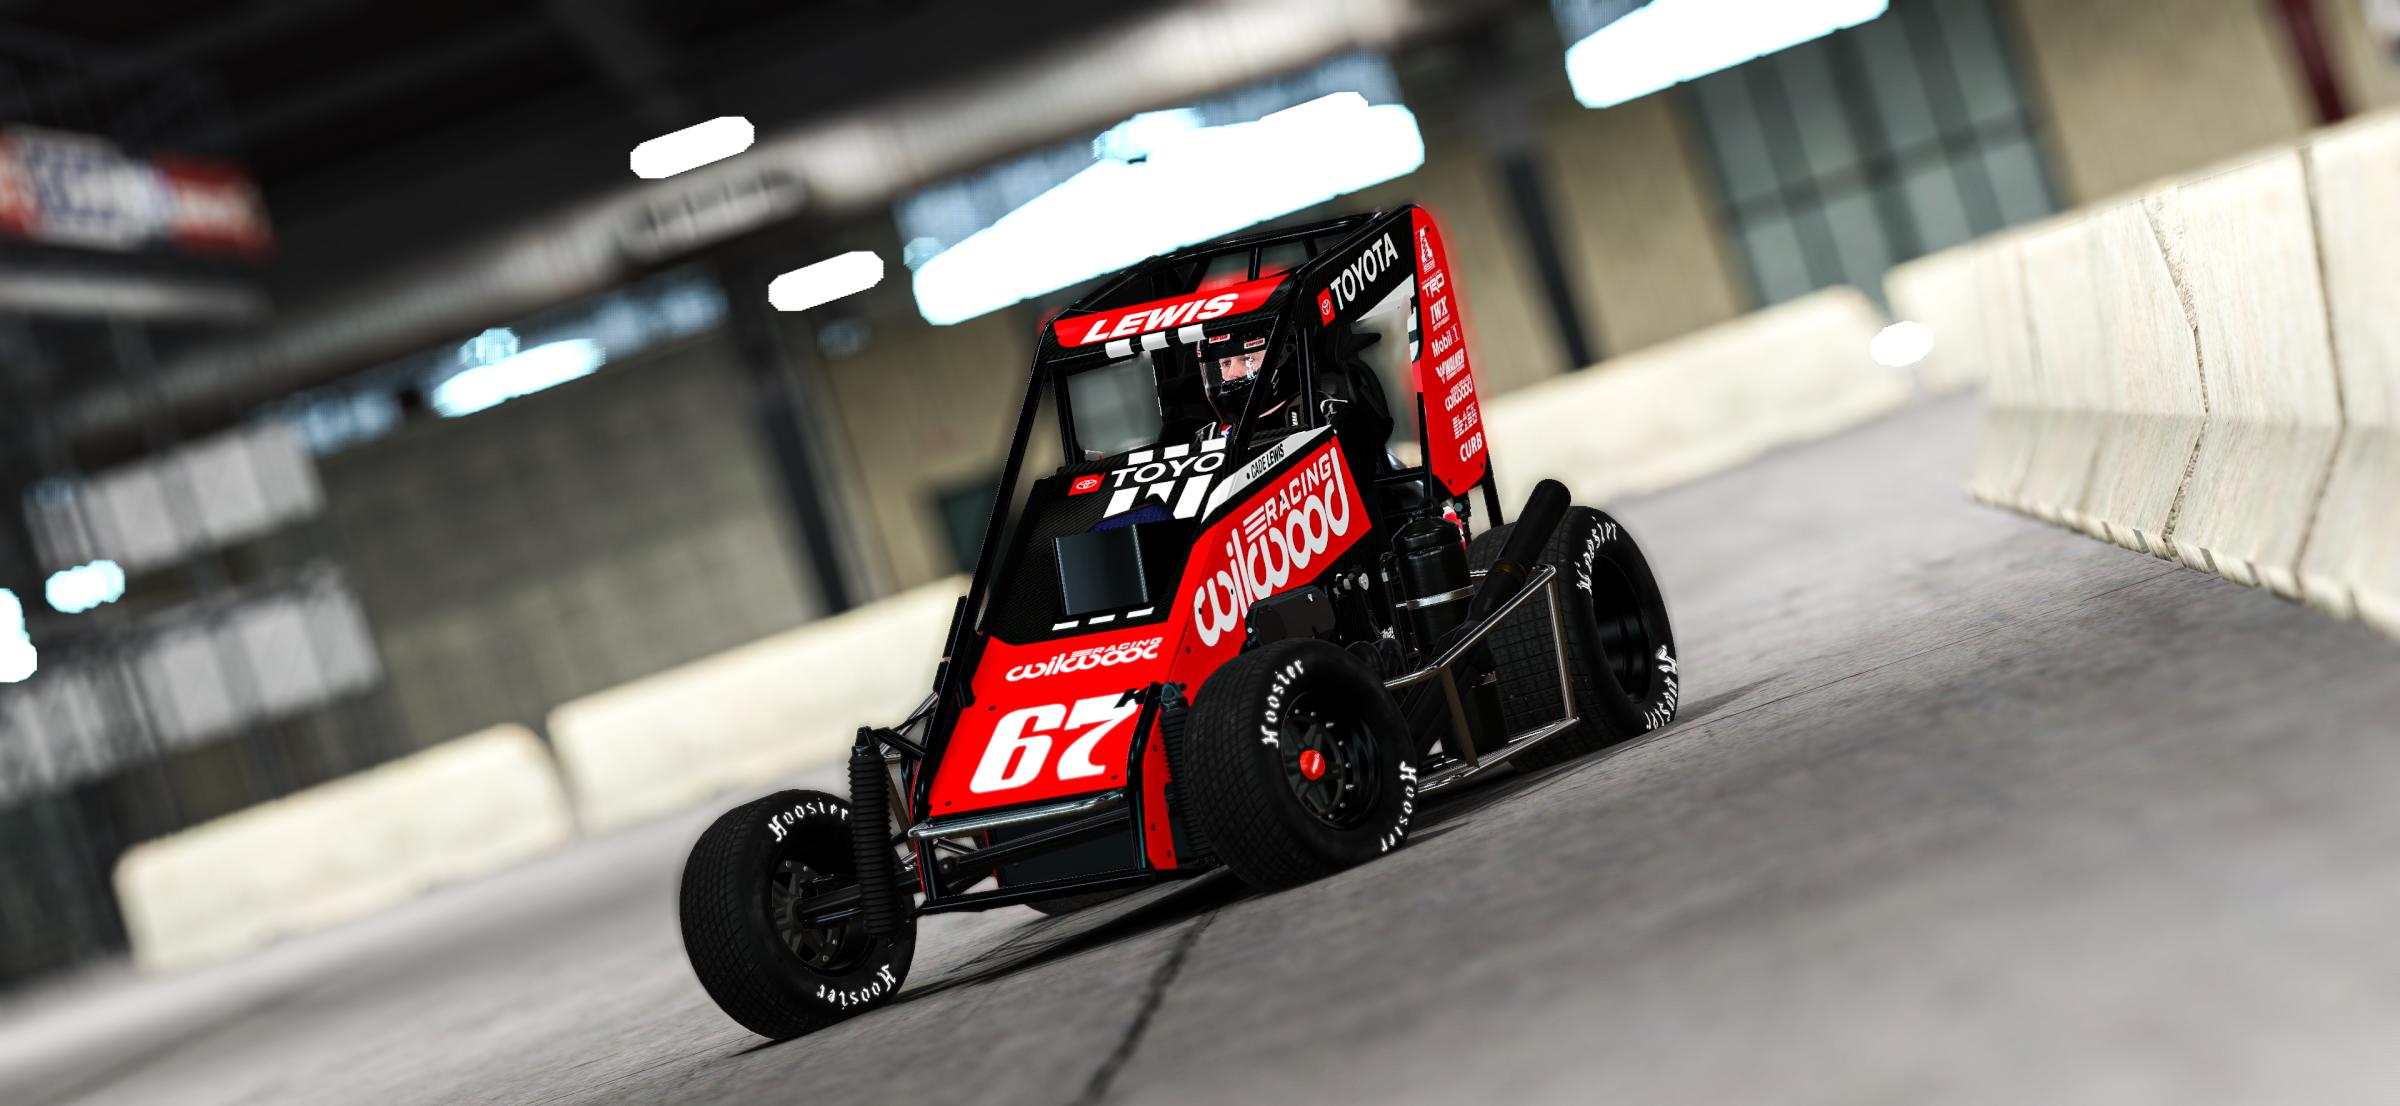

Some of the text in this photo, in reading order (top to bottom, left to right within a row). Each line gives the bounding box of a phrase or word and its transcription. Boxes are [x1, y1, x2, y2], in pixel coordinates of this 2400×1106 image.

[1330, 232, 1399, 311] TOYOTA
[1422, 272, 1445, 298] TRD
[1080, 293, 1239, 344] LEWIS
[1430, 296, 1448, 325] IWX
[1431, 330, 1452, 358] Mobil
[1250, 443, 1284, 479] CADE LEWIS
[1460, 432, 1482, 462] CURB
[1111, 452, 1227, 487] TOYO
[1264, 453, 1332, 525] RACING
[1194, 446, 1350, 647] wilwood
[1092, 637, 1163, 655] RACING
[1261, 659, 1304, 748] Hoosier
[768, 798, 849, 842] Hoosier
[1377, 761, 1418, 852] Hoosier
[816, 964, 897, 1010] Hoosier
